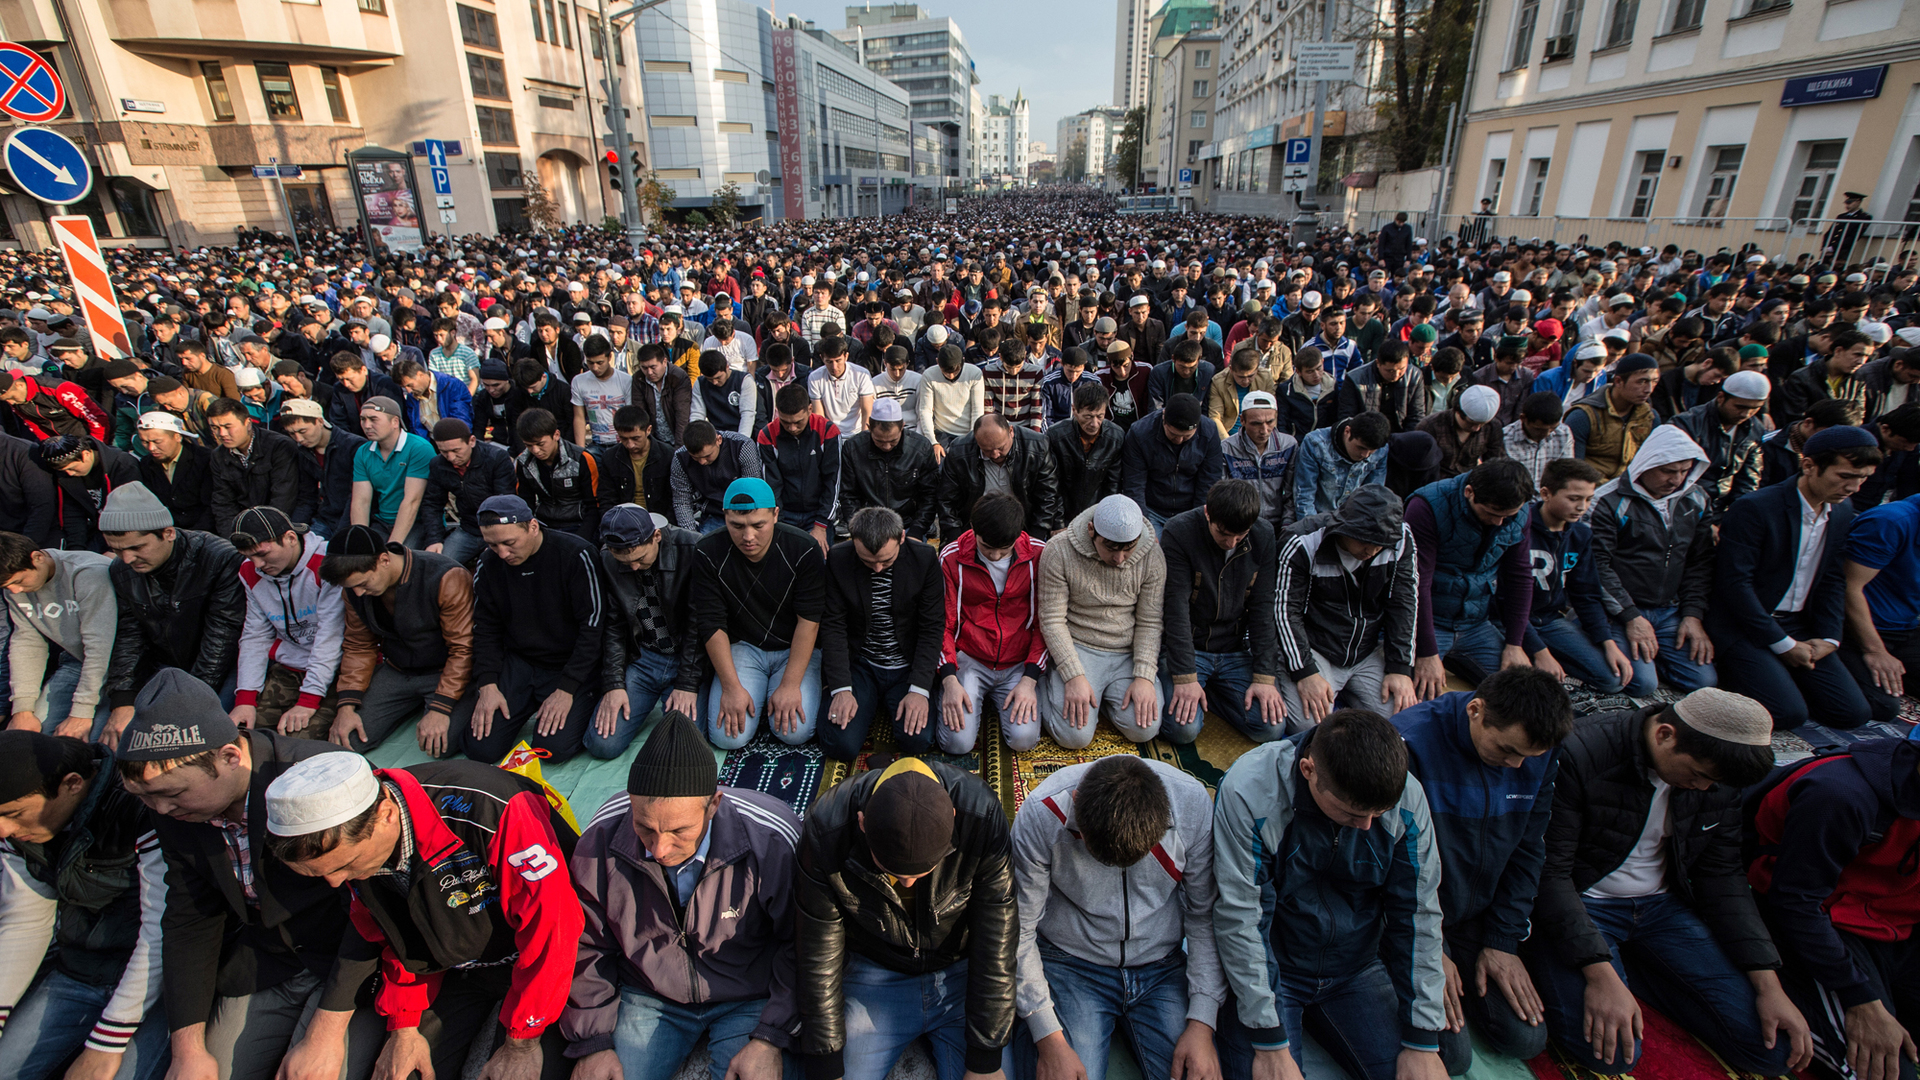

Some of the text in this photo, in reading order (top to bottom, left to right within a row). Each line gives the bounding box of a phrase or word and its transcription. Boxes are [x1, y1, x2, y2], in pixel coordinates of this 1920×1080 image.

[774, 36, 787, 136] ПАРКОВОЧНЫХ
[1806, 77, 1853, 93] ЩЕПКИНА
[784, 36, 802, 208] 8 903 137 64 37
[127, 724, 206, 752] LONSDALE
[441, 795, 473, 813] Plus
[507, 843, 558, 882] 3
